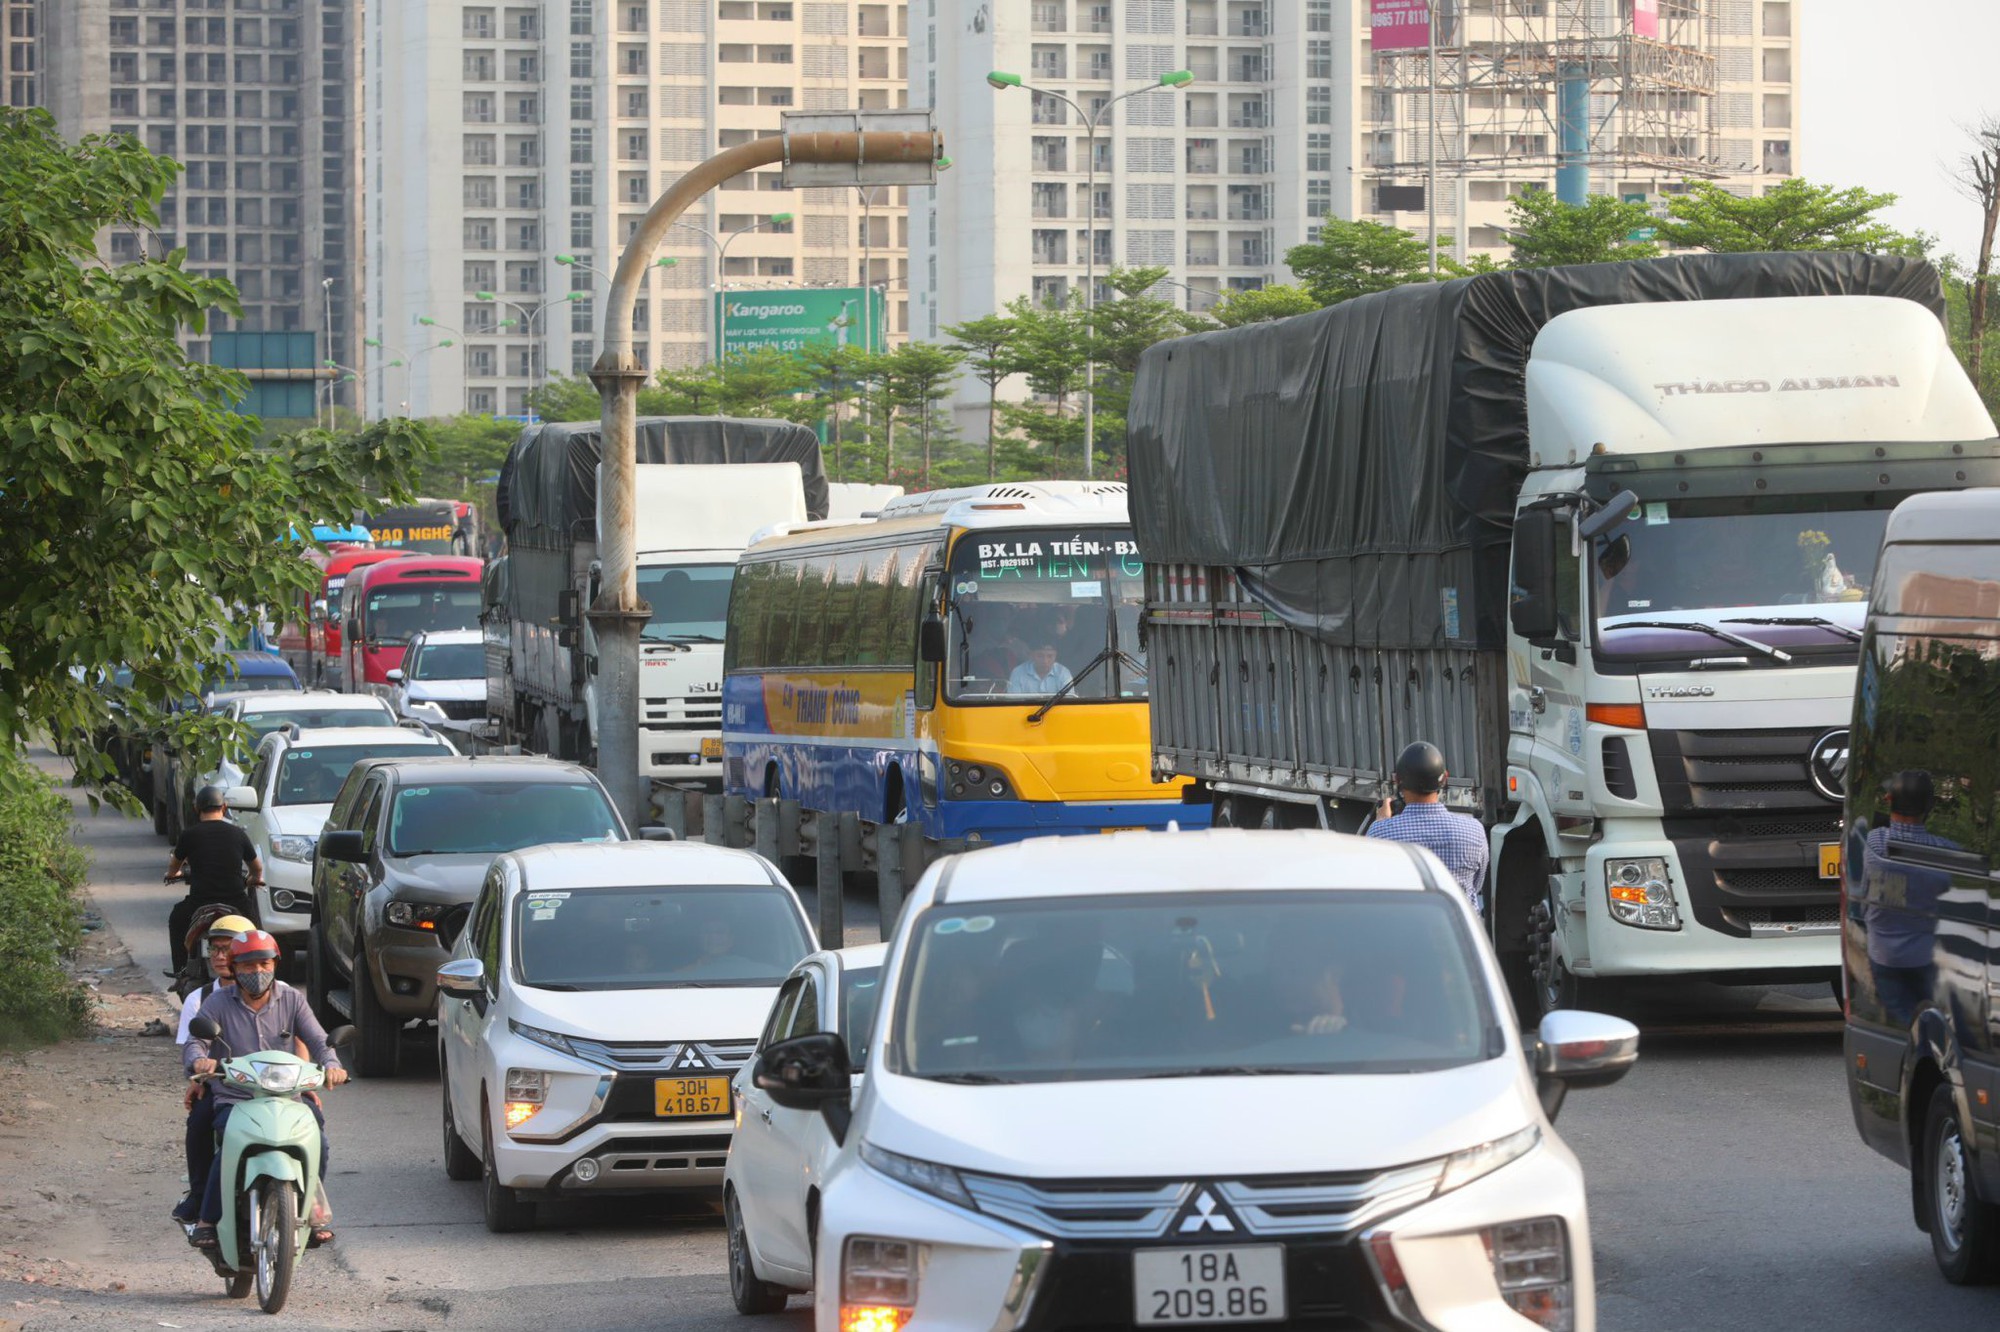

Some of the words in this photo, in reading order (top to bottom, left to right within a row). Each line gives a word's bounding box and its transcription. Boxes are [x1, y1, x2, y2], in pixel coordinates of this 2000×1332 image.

[1394, 11, 1406, 25] 77
[726, 302, 805, 319] Kangaroo
[1654, 379, 1772, 396] THACO
[1777, 375, 1901, 391] AUMAN
[371, 528, 403, 542] SAO
[408, 525, 452, 542] NGHỆ
[978, 542, 1043, 558] BX.LA
[1050, 534, 1100, 555] TIẾN
[689, 682, 722, 693] ISU
[1647, 685, 1715, 697] THACO
[676, 1080, 708, 1096] 30H
[664, 1096, 721, 1114] 418.67
[1182, 1252, 1240, 1283] 18A
[1152, 1286, 1267, 1319] 209.86
